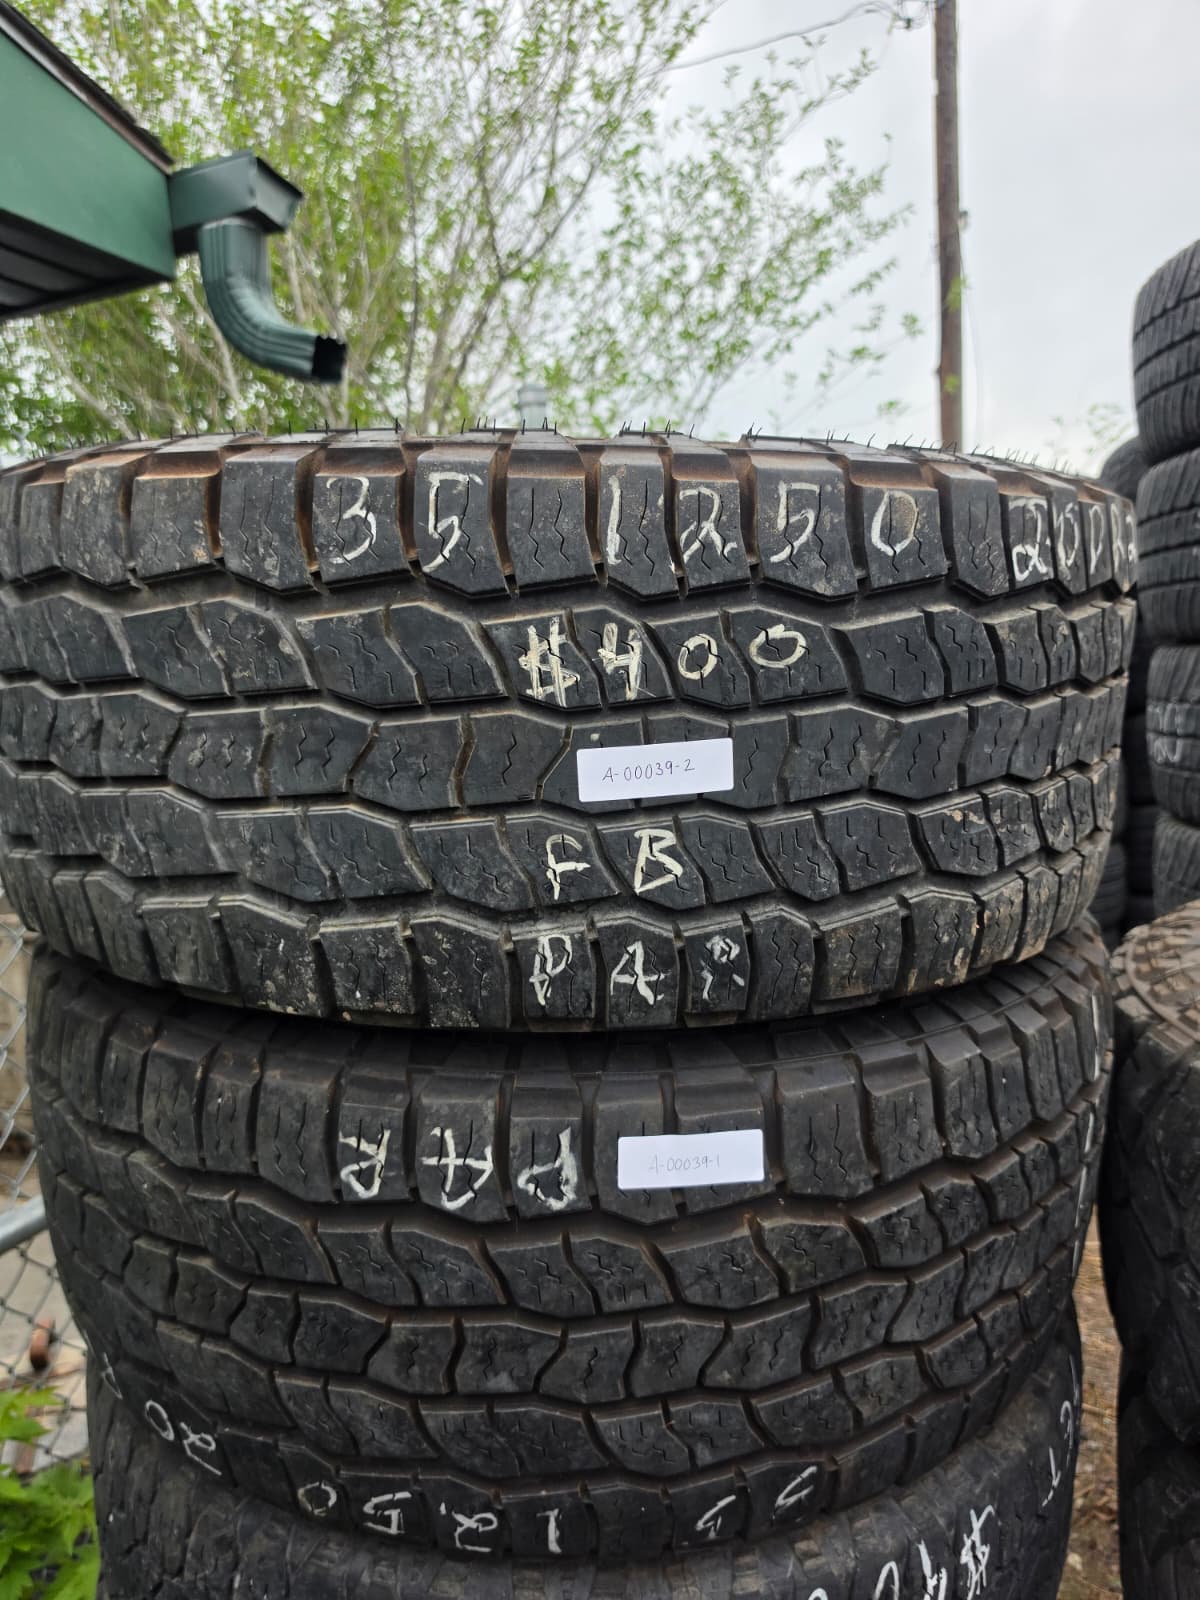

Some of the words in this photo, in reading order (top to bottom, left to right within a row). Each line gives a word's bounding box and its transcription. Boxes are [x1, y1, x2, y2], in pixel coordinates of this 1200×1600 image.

[324, 470, 484, 574] 35
[601, 757, 696, 784] A-00039-2
[648, 1153, 721, 1176] A-00039-1
